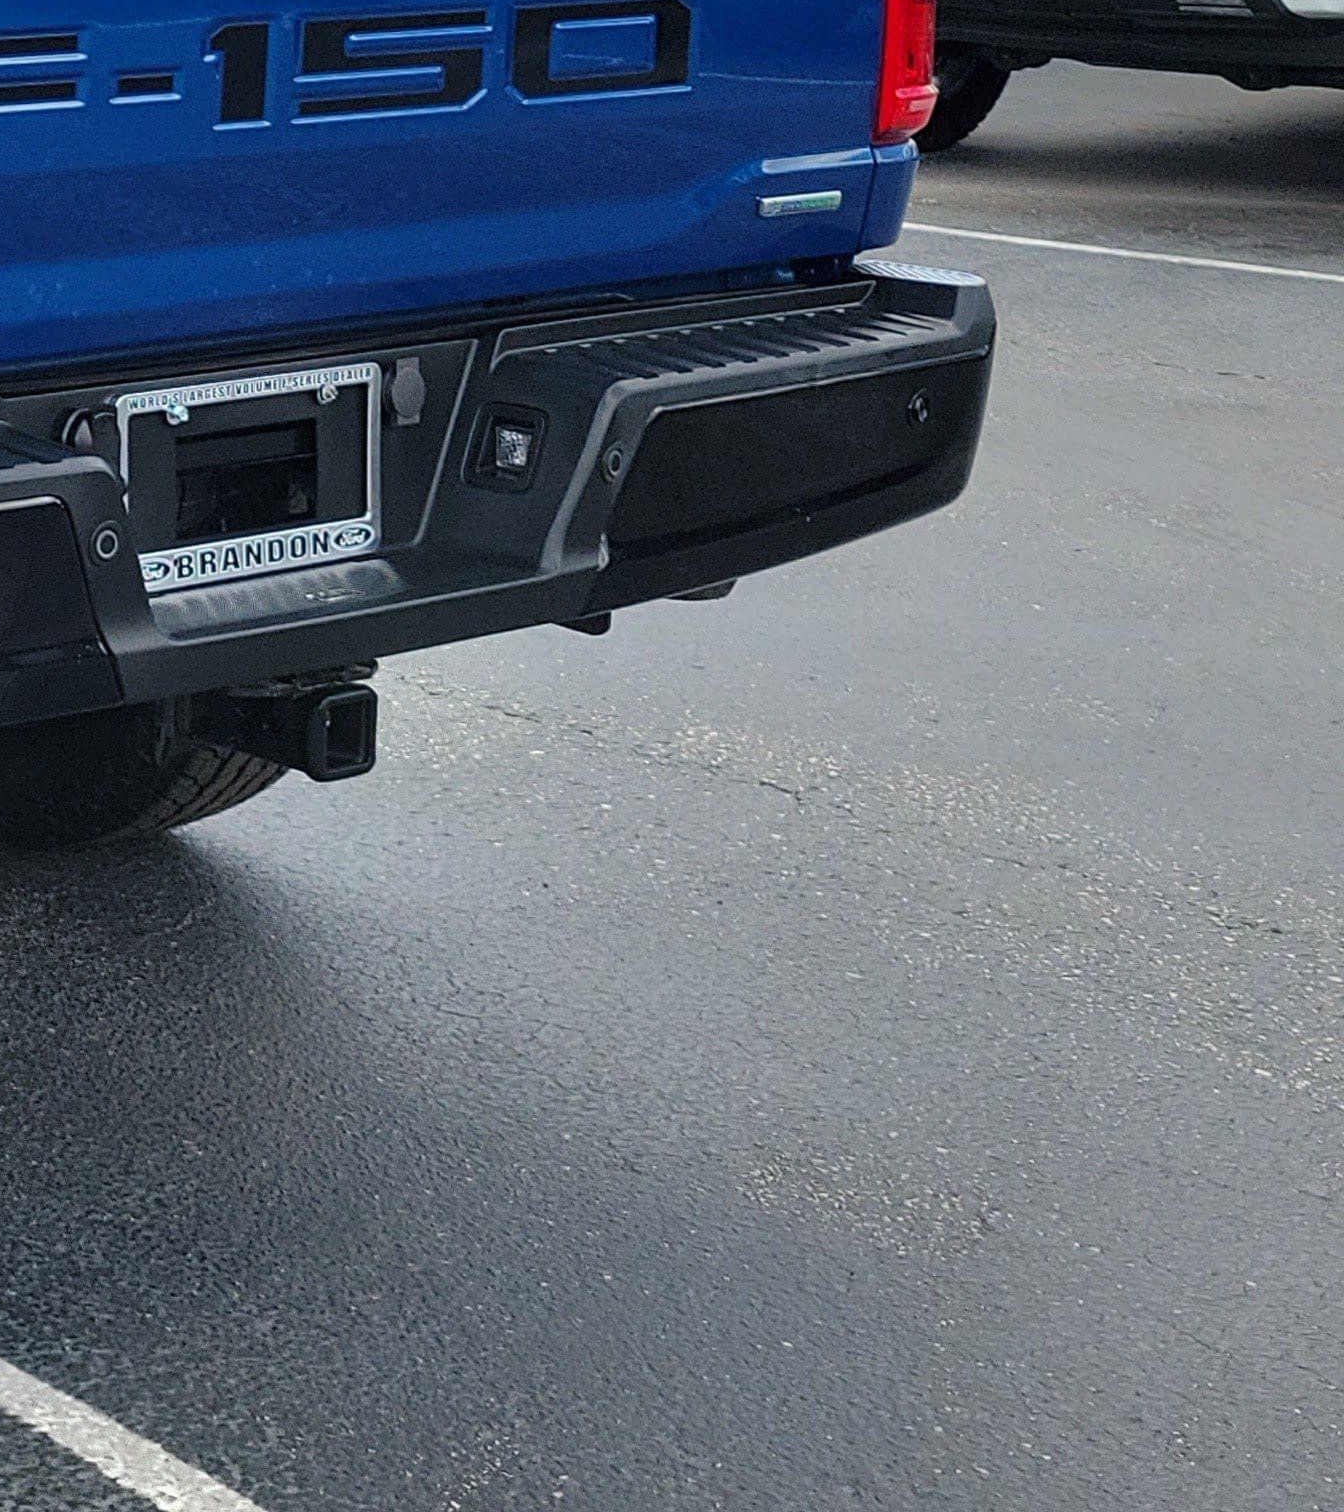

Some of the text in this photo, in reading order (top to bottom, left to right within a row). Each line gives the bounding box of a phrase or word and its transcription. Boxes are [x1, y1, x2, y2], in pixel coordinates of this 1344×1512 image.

[183, 385, 231, 402] LARGEST
[235, 379, 278, 395] VOLUME
[332, 367, 372, 383] DEALER
[177, 530, 331, 579] BRANDON
